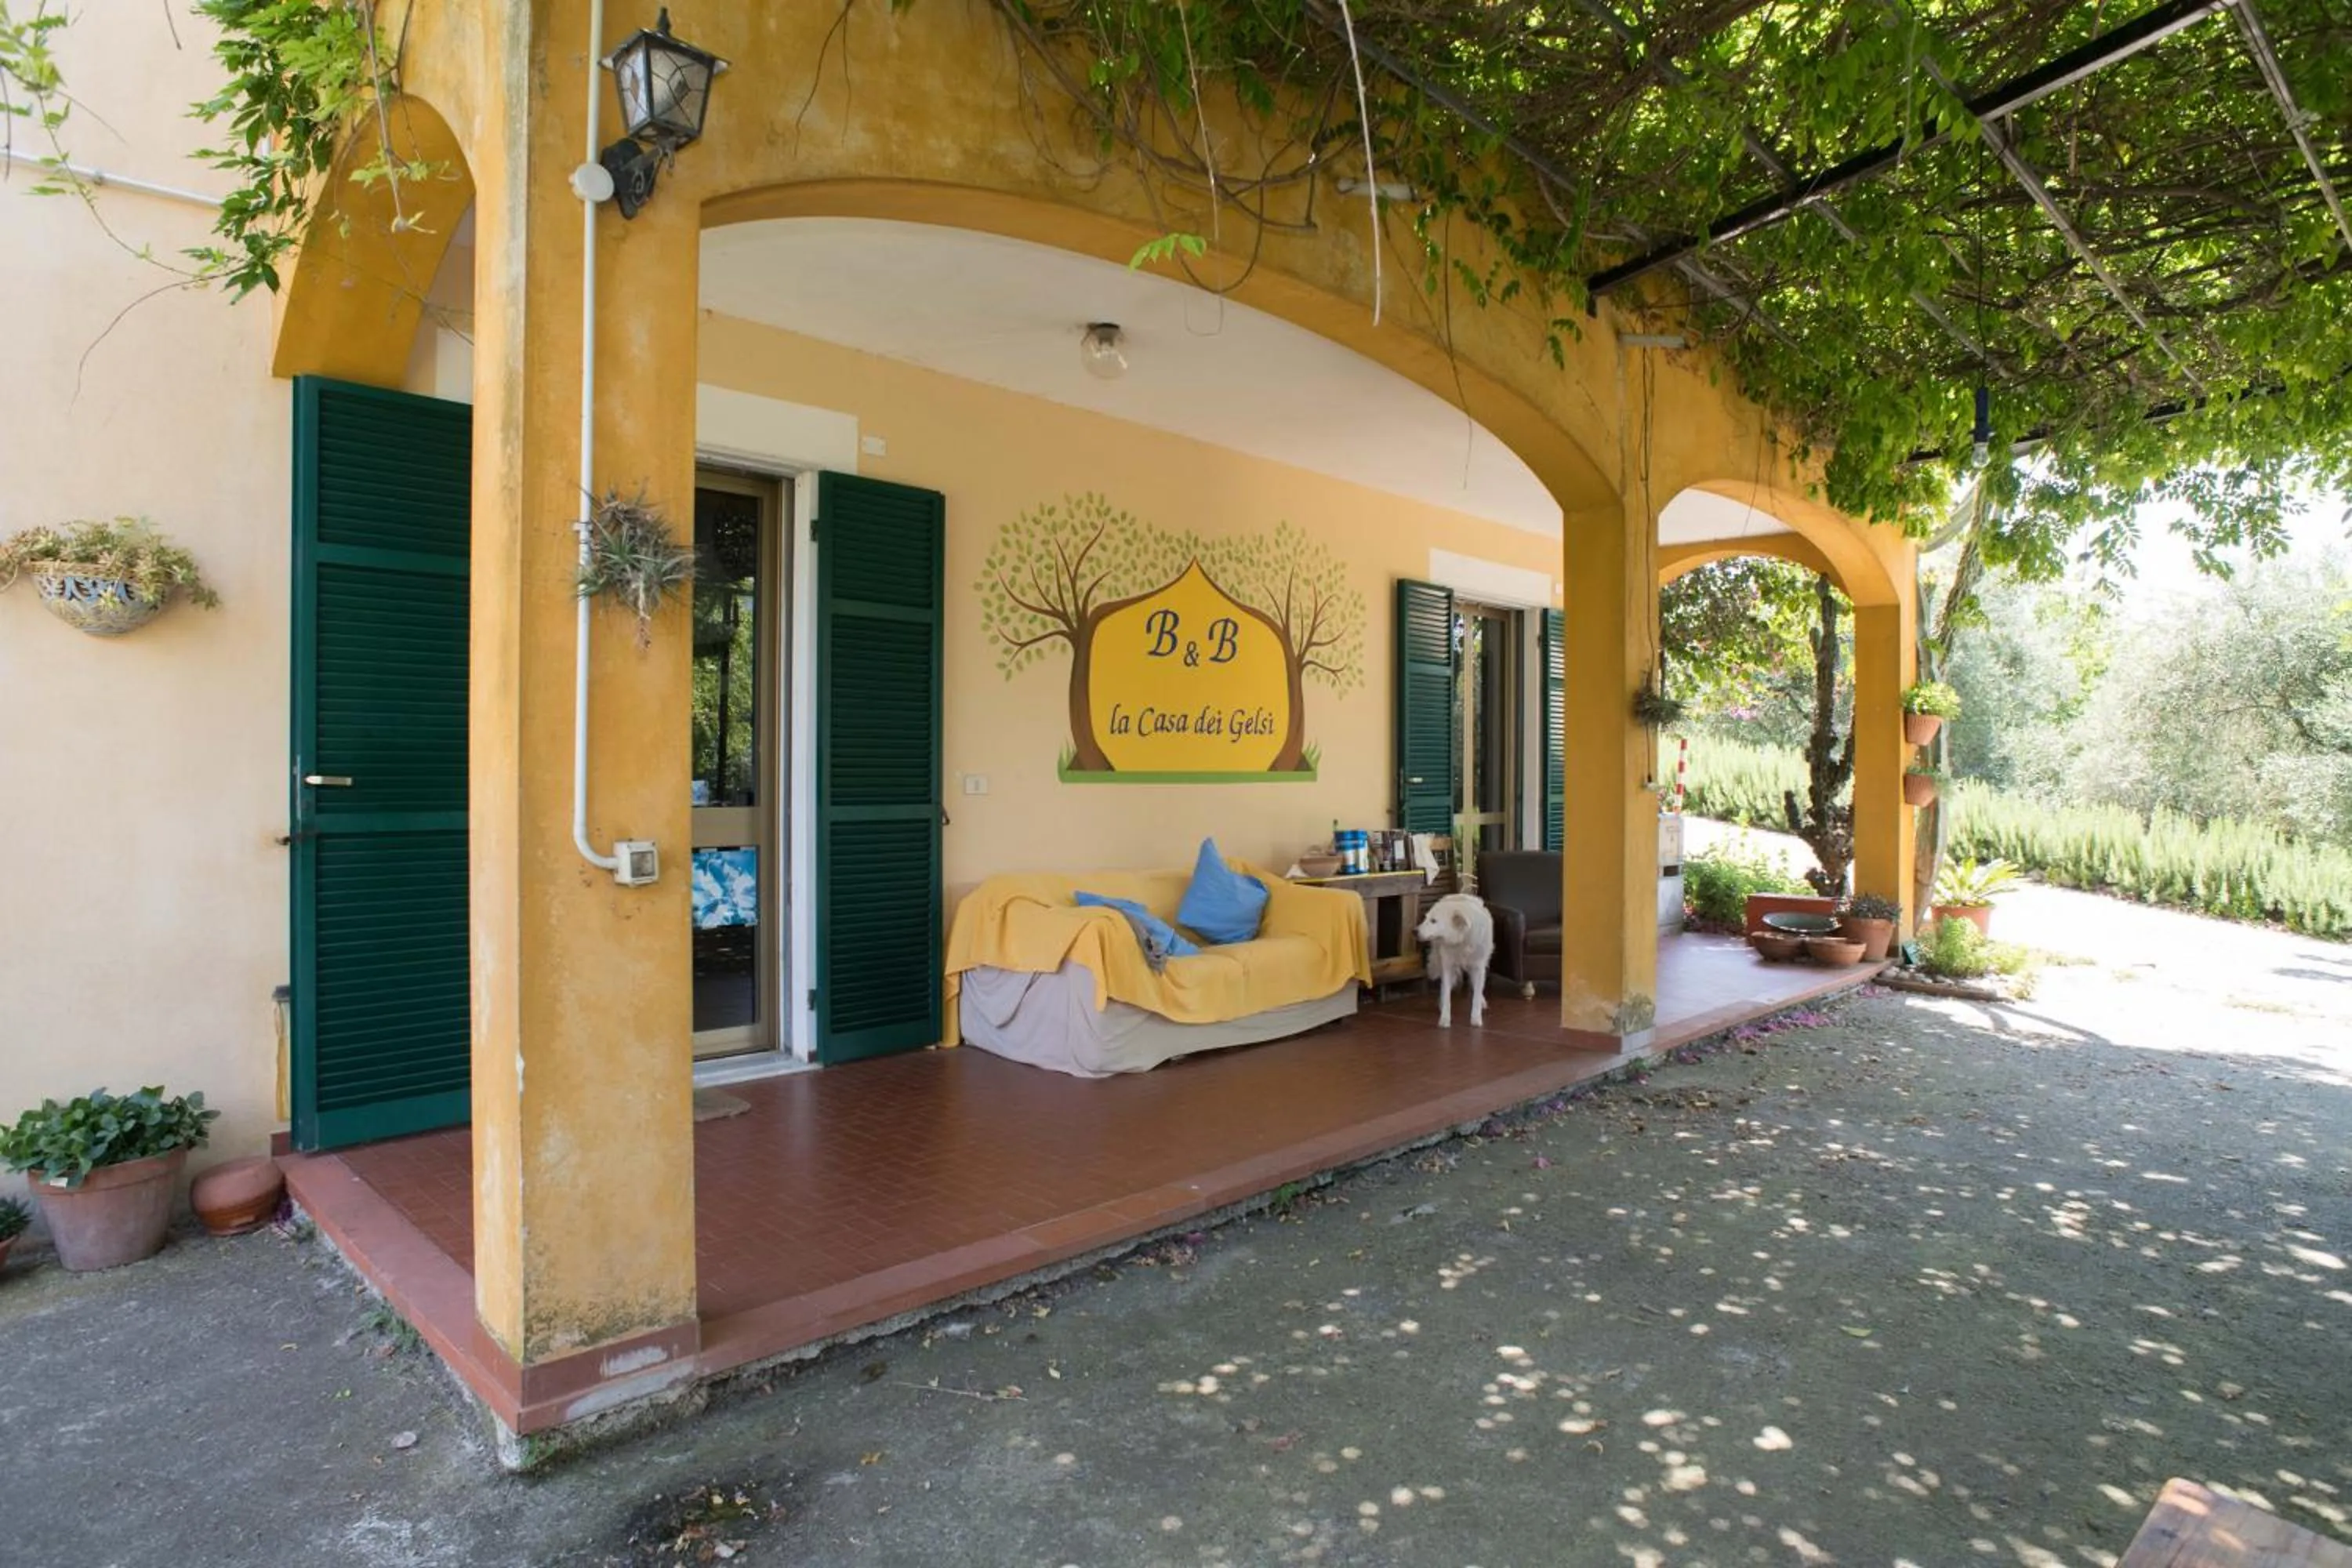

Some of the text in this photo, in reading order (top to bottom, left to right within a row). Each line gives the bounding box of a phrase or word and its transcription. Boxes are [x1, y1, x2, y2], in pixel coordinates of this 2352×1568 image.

[1145, 608, 1239, 667] B & B
[1109, 702, 1275, 743] la Casa dei Gelsi
